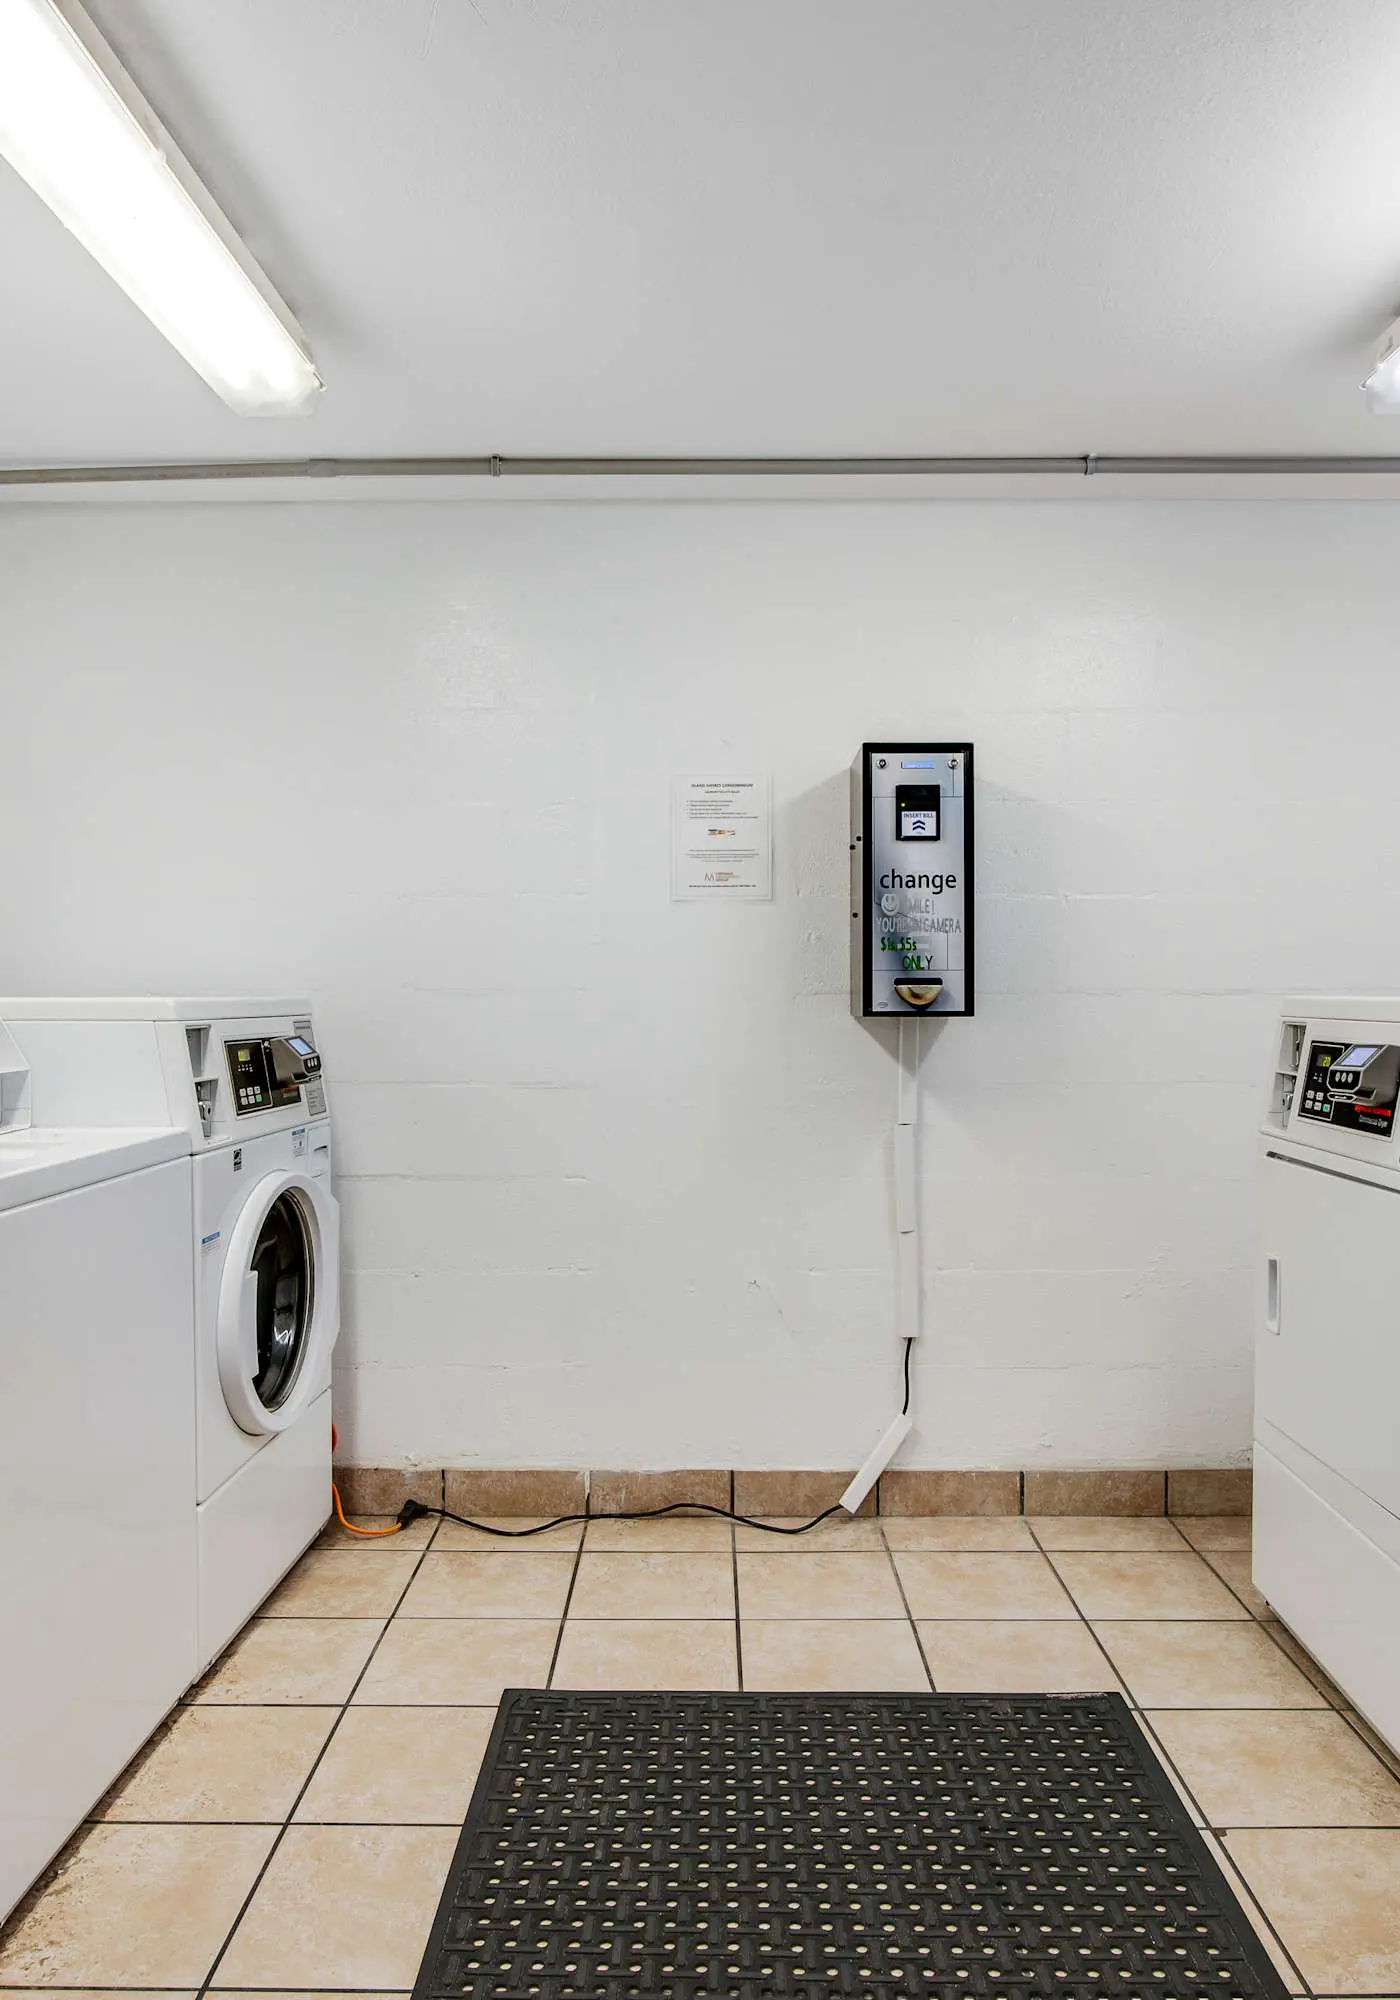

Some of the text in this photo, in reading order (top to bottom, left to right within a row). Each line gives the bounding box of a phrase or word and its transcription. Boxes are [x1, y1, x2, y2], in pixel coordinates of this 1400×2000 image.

[880, 868, 957, 894] change
[923, 917, 962, 933] CAMERA
[902, 955, 934, 970] ONLY
